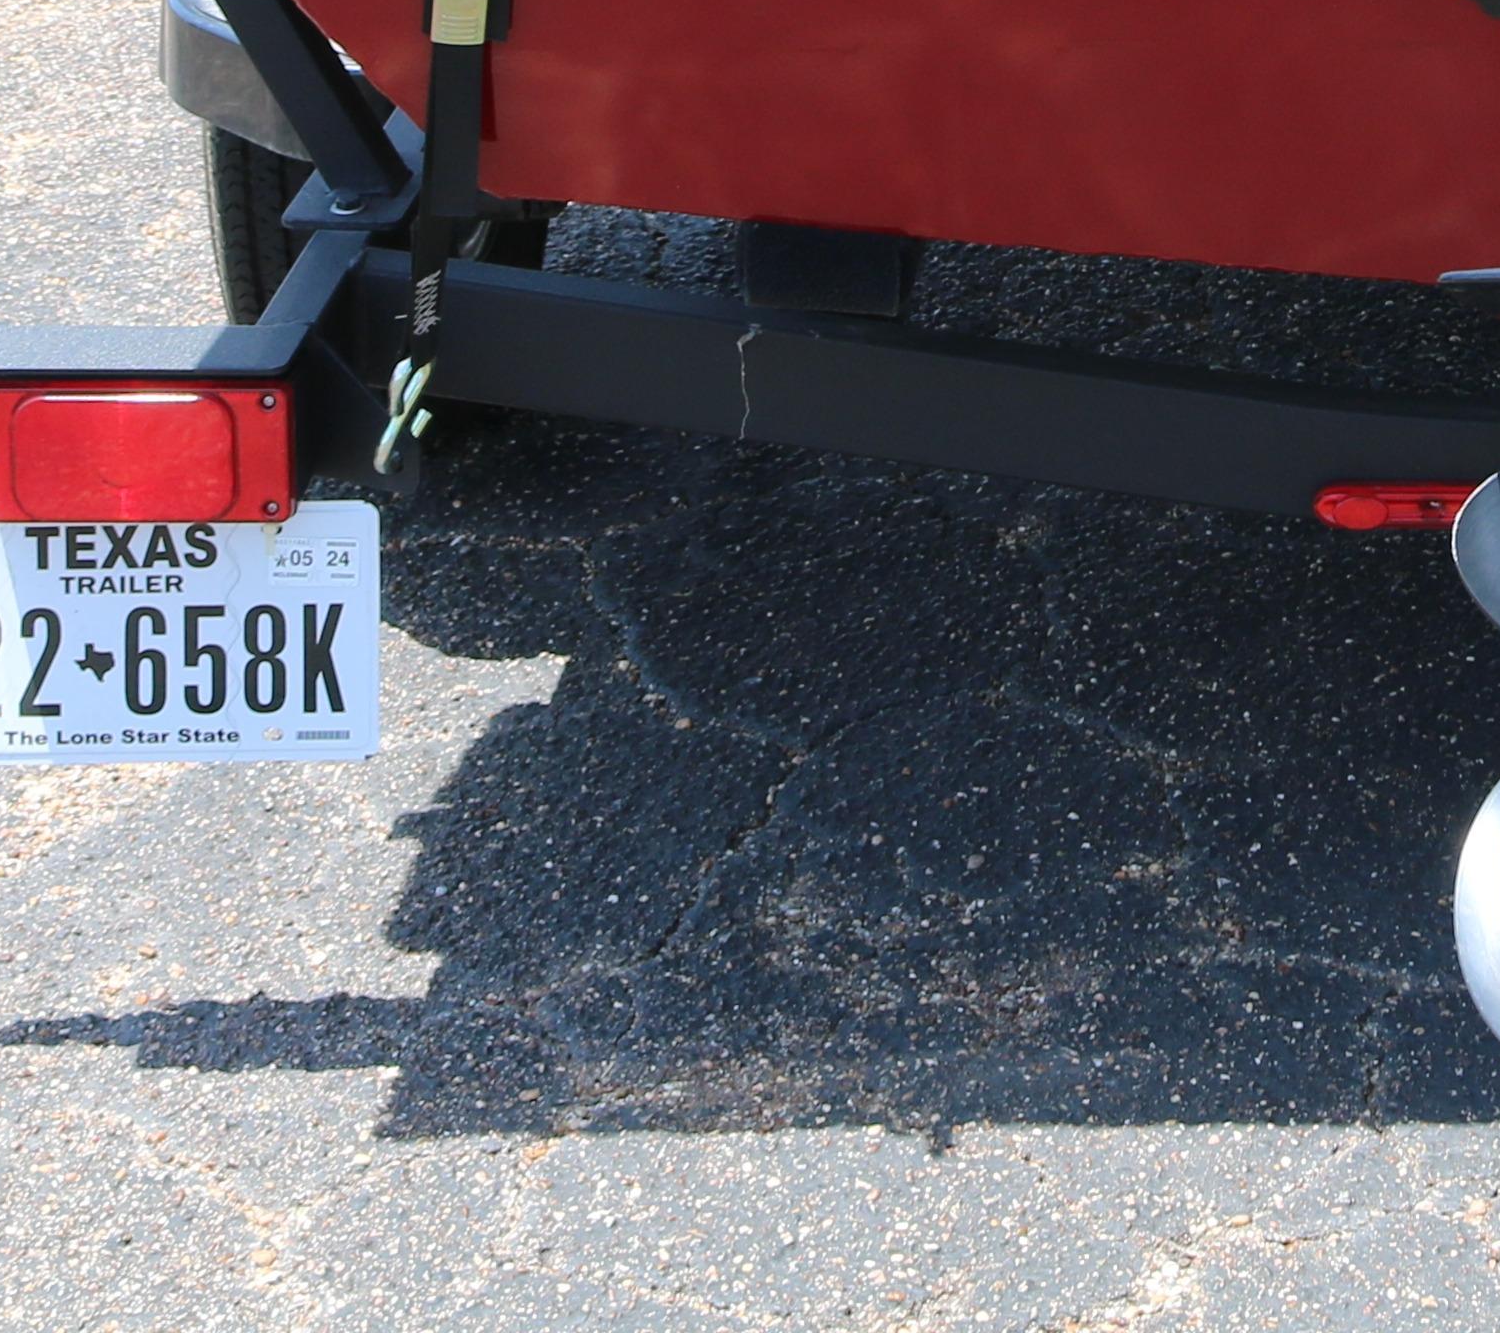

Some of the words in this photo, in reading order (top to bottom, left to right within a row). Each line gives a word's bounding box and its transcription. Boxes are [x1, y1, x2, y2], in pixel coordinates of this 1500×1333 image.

[25, 524, 218, 571] TEXAS
[290, 550, 313, 566] 05
[326, 550, 350, 567] 24
[59, 574, 184, 595] TRAILER
[123, 603, 346, 716] 658K
[4, 729, 49, 746] The
[56, 728, 115, 746] Lone
[121, 728, 169, 745] Star
[177, 727, 241, 744] State
